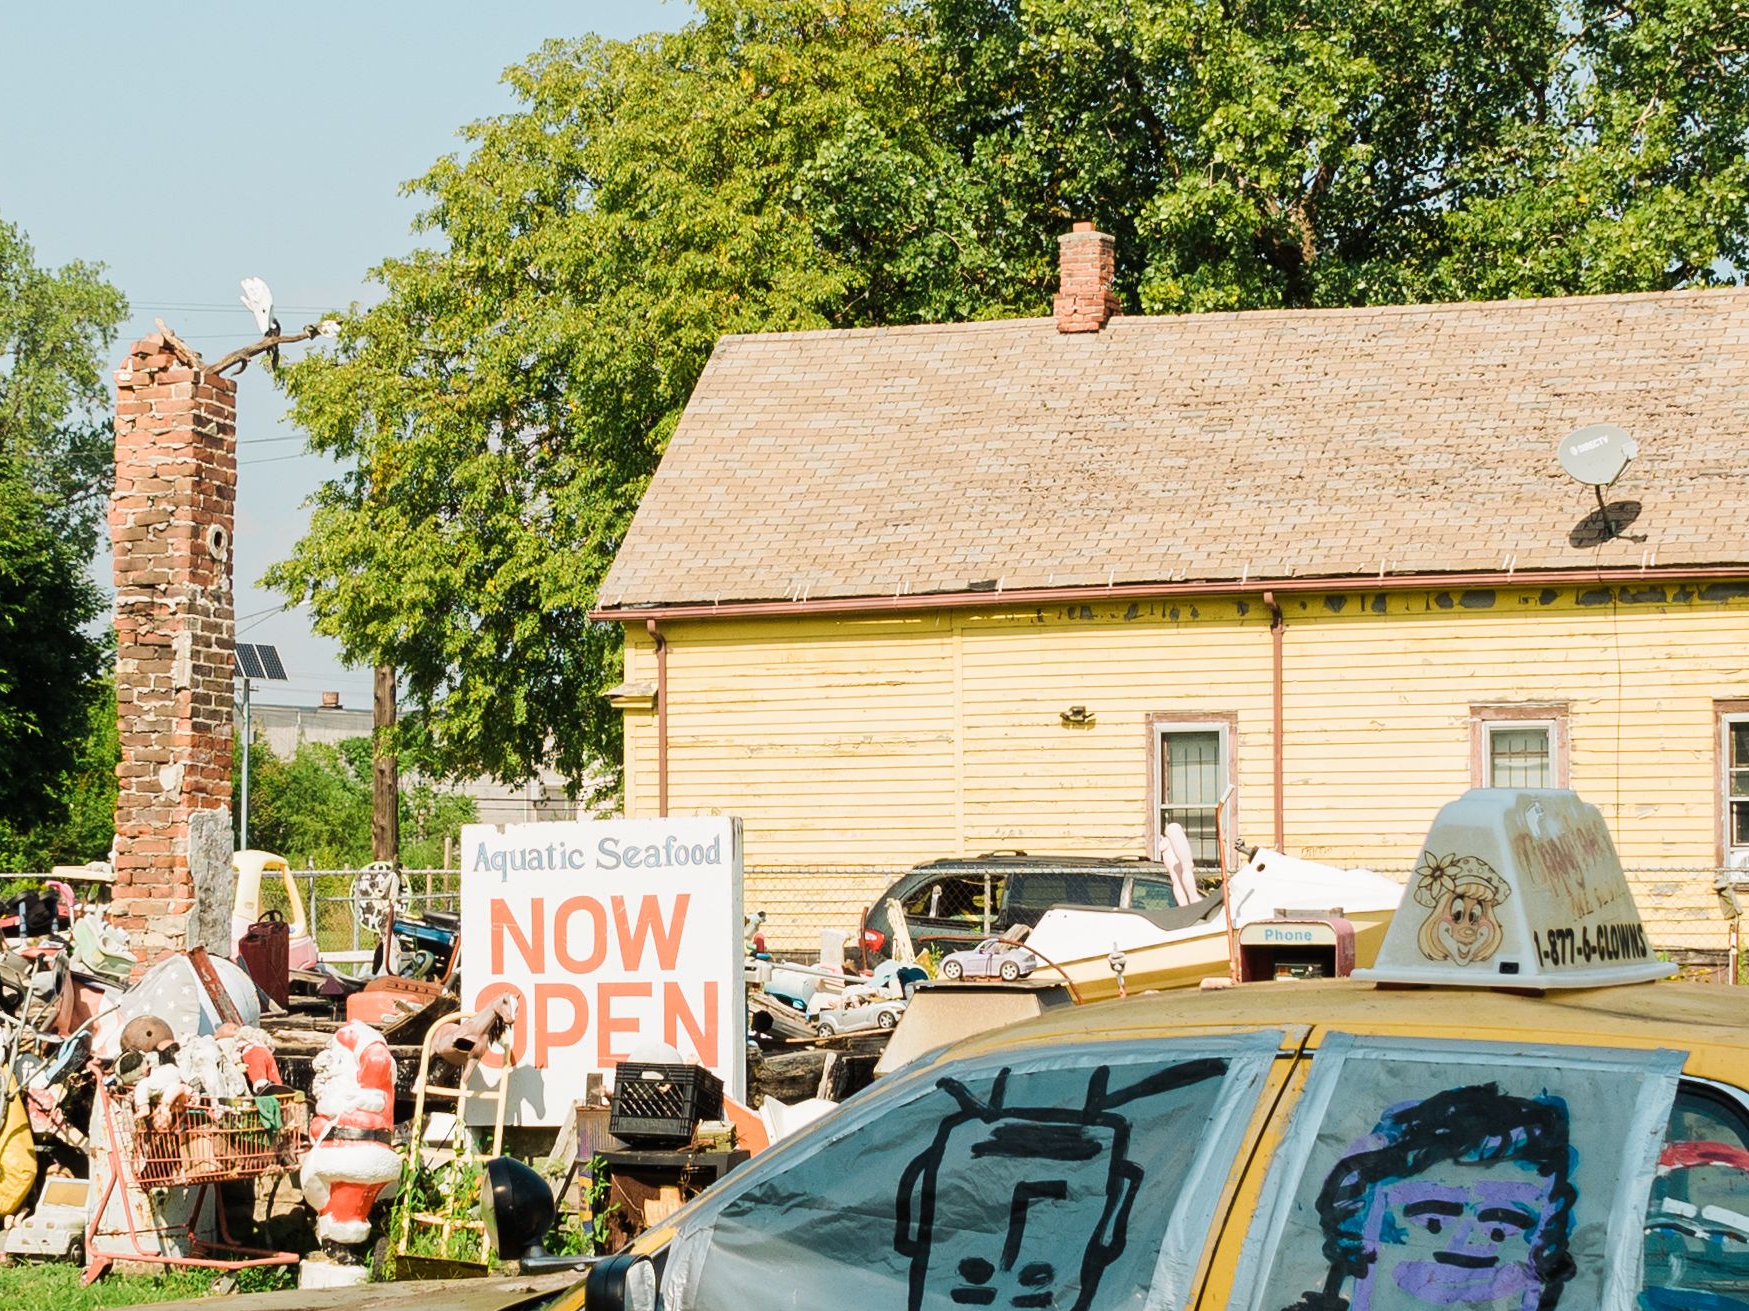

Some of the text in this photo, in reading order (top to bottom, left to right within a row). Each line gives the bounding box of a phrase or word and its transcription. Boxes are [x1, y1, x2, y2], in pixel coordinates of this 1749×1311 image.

[473, 834, 722, 883] Aquatic Seafood
[490, 893, 691, 975] NOW
[1264, 928, 1313, 941] Phone
[1533, 923, 1648, 968] 1-877-6-CLOWNS
[474, 980, 719, 1069] OPEN
